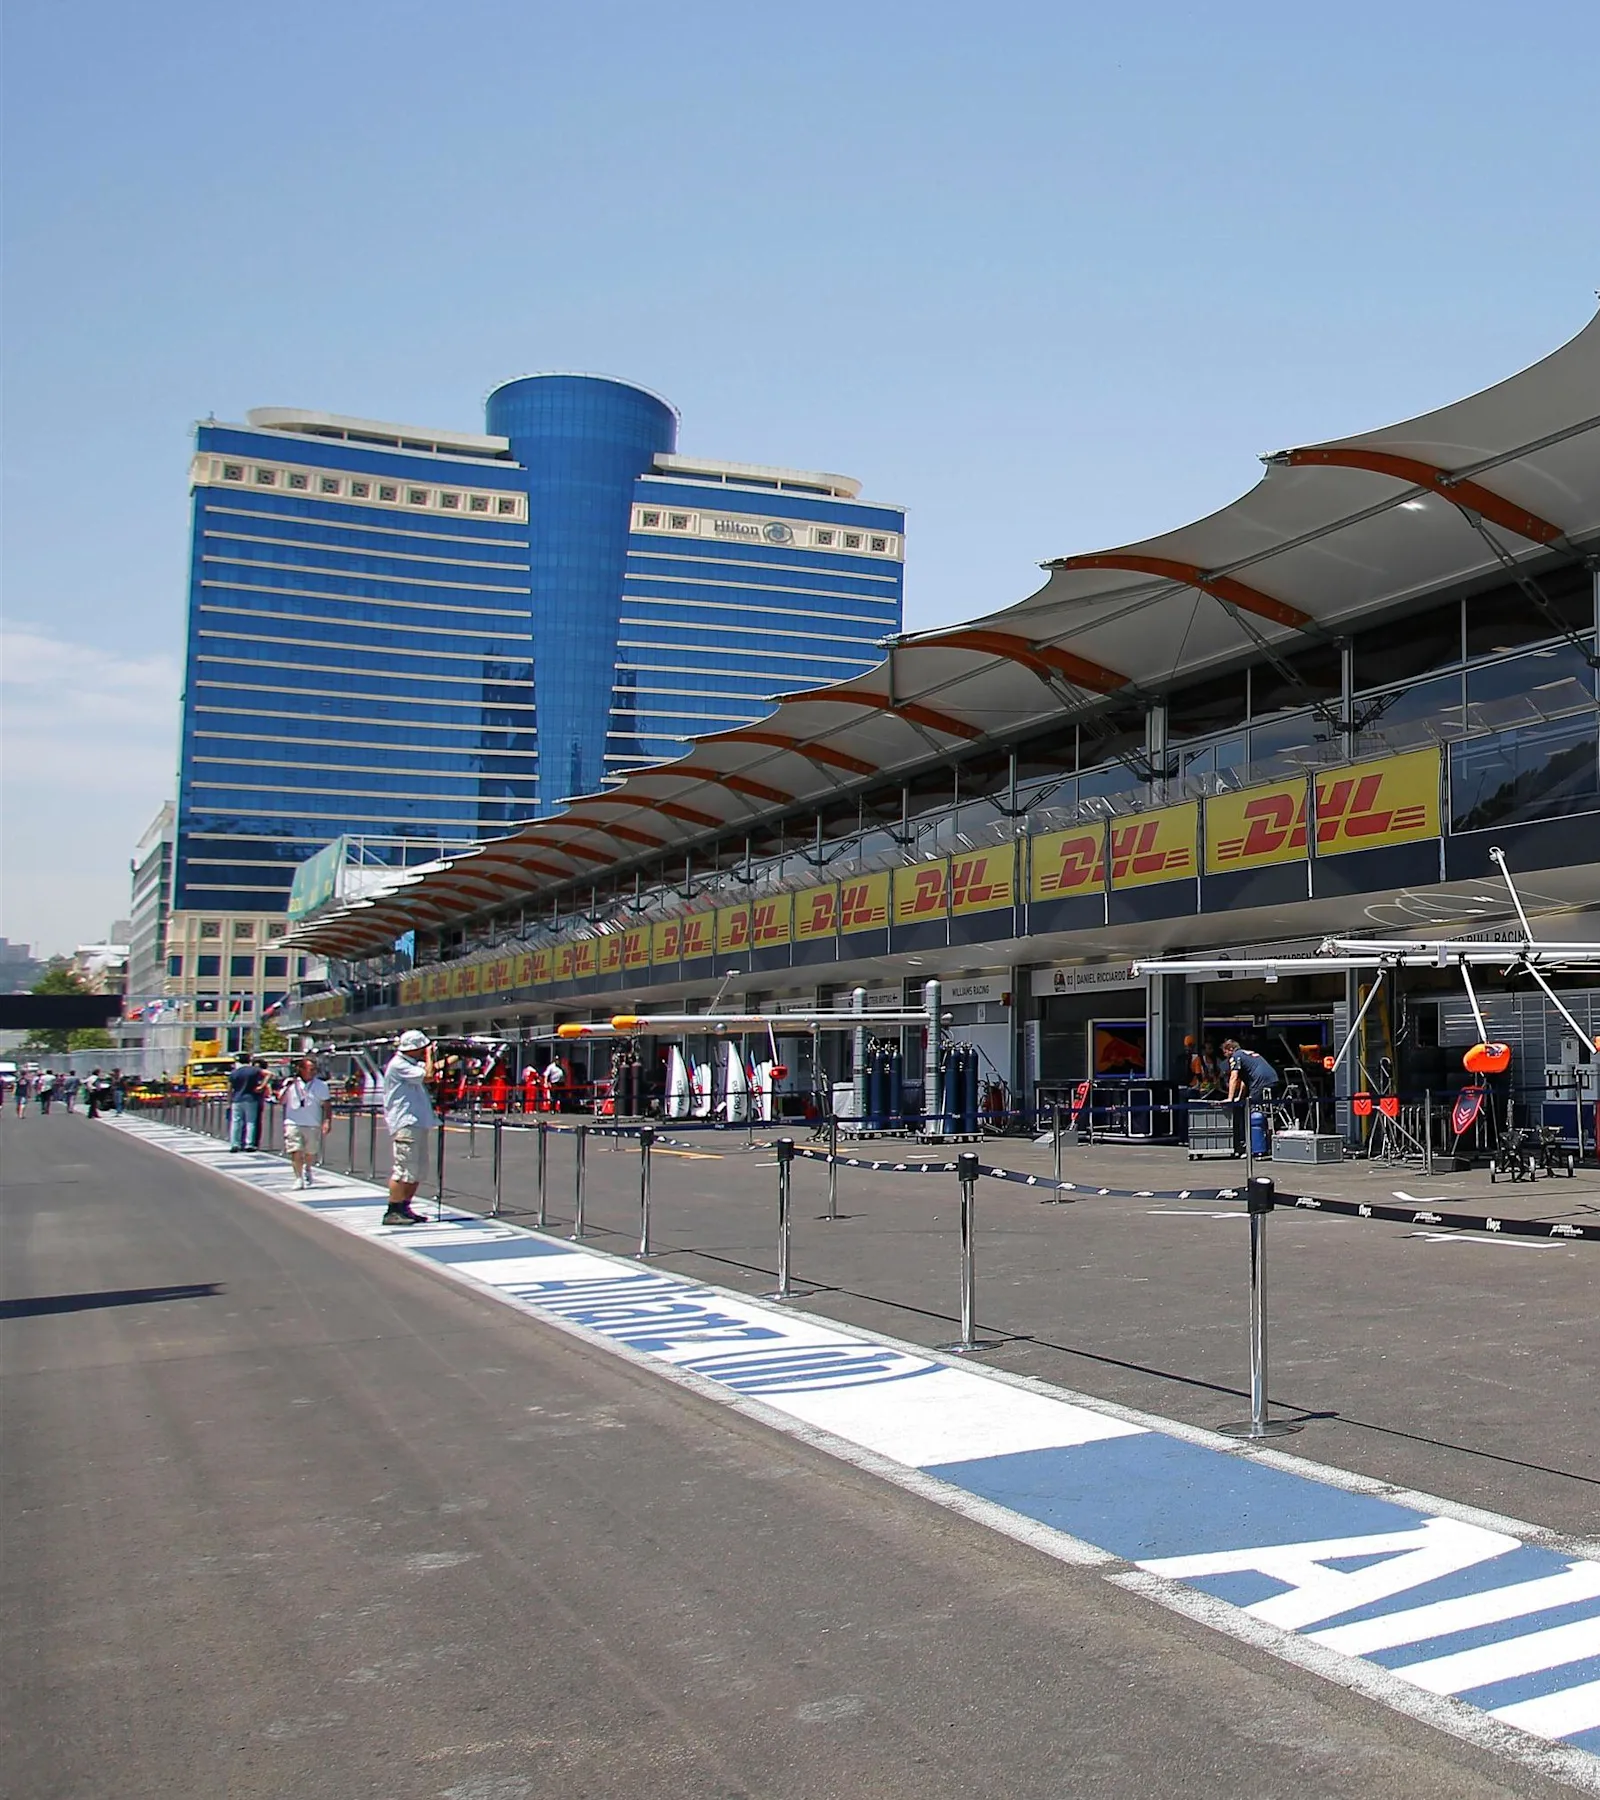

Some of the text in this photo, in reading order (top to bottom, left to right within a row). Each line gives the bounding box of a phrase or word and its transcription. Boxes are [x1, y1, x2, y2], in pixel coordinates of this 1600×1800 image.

[713, 519, 759, 535] Hilton
[1242, 774, 1395, 857] DHL
[1058, 821, 1168, 889] DHL
[914, 858, 993, 912] DHL
[730, 904, 779, 946] DHL
[811, 885, 874, 932] DHL
[608, 934, 642, 966] DHL
[664, 922, 704, 957] DHL
[973, 985, 990, 995] RACING
[1076, 973, 1096, 985] DANIEL
[1097, 970, 1126, 984] RICCIARDO
